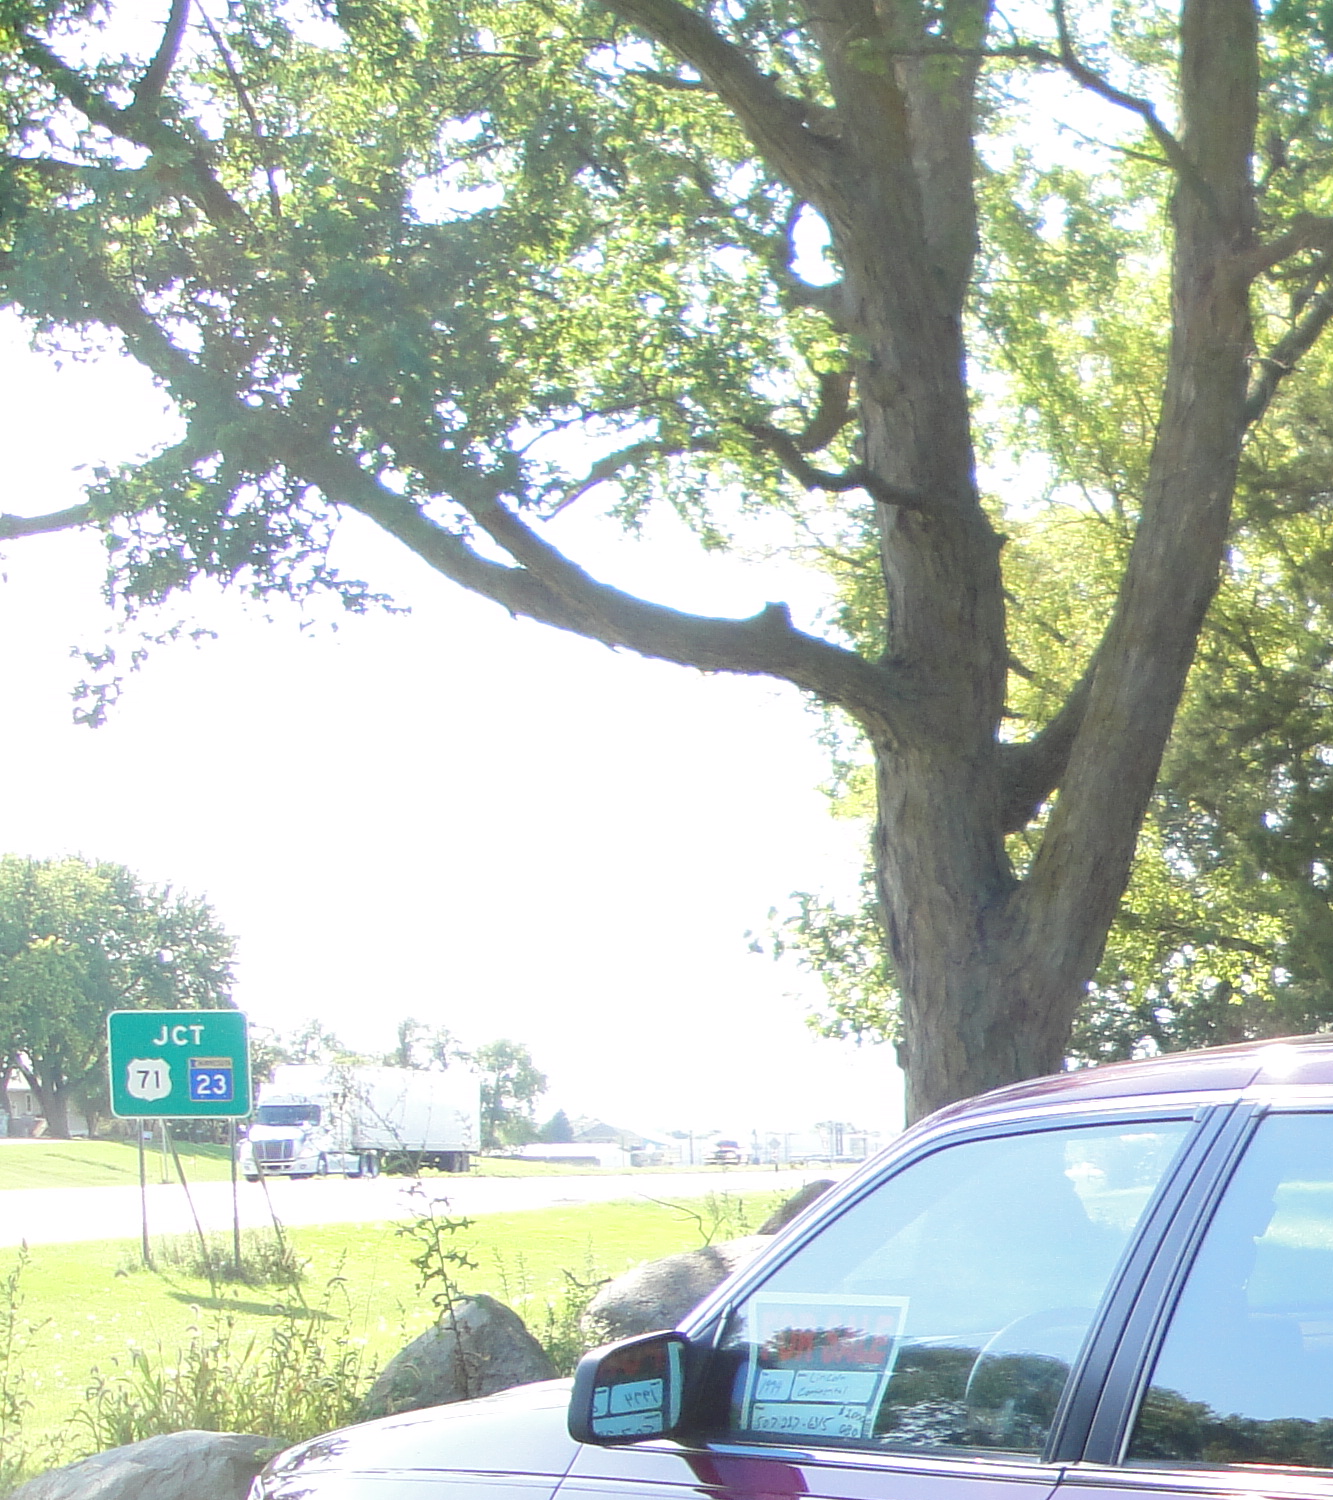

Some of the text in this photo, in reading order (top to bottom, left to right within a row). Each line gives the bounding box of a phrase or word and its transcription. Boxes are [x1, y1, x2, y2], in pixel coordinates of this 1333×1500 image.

[153, 1025, 205, 1046] JCT
[136, 1069, 160, 1090] 71
[196, 1074, 227, 1095] 23
